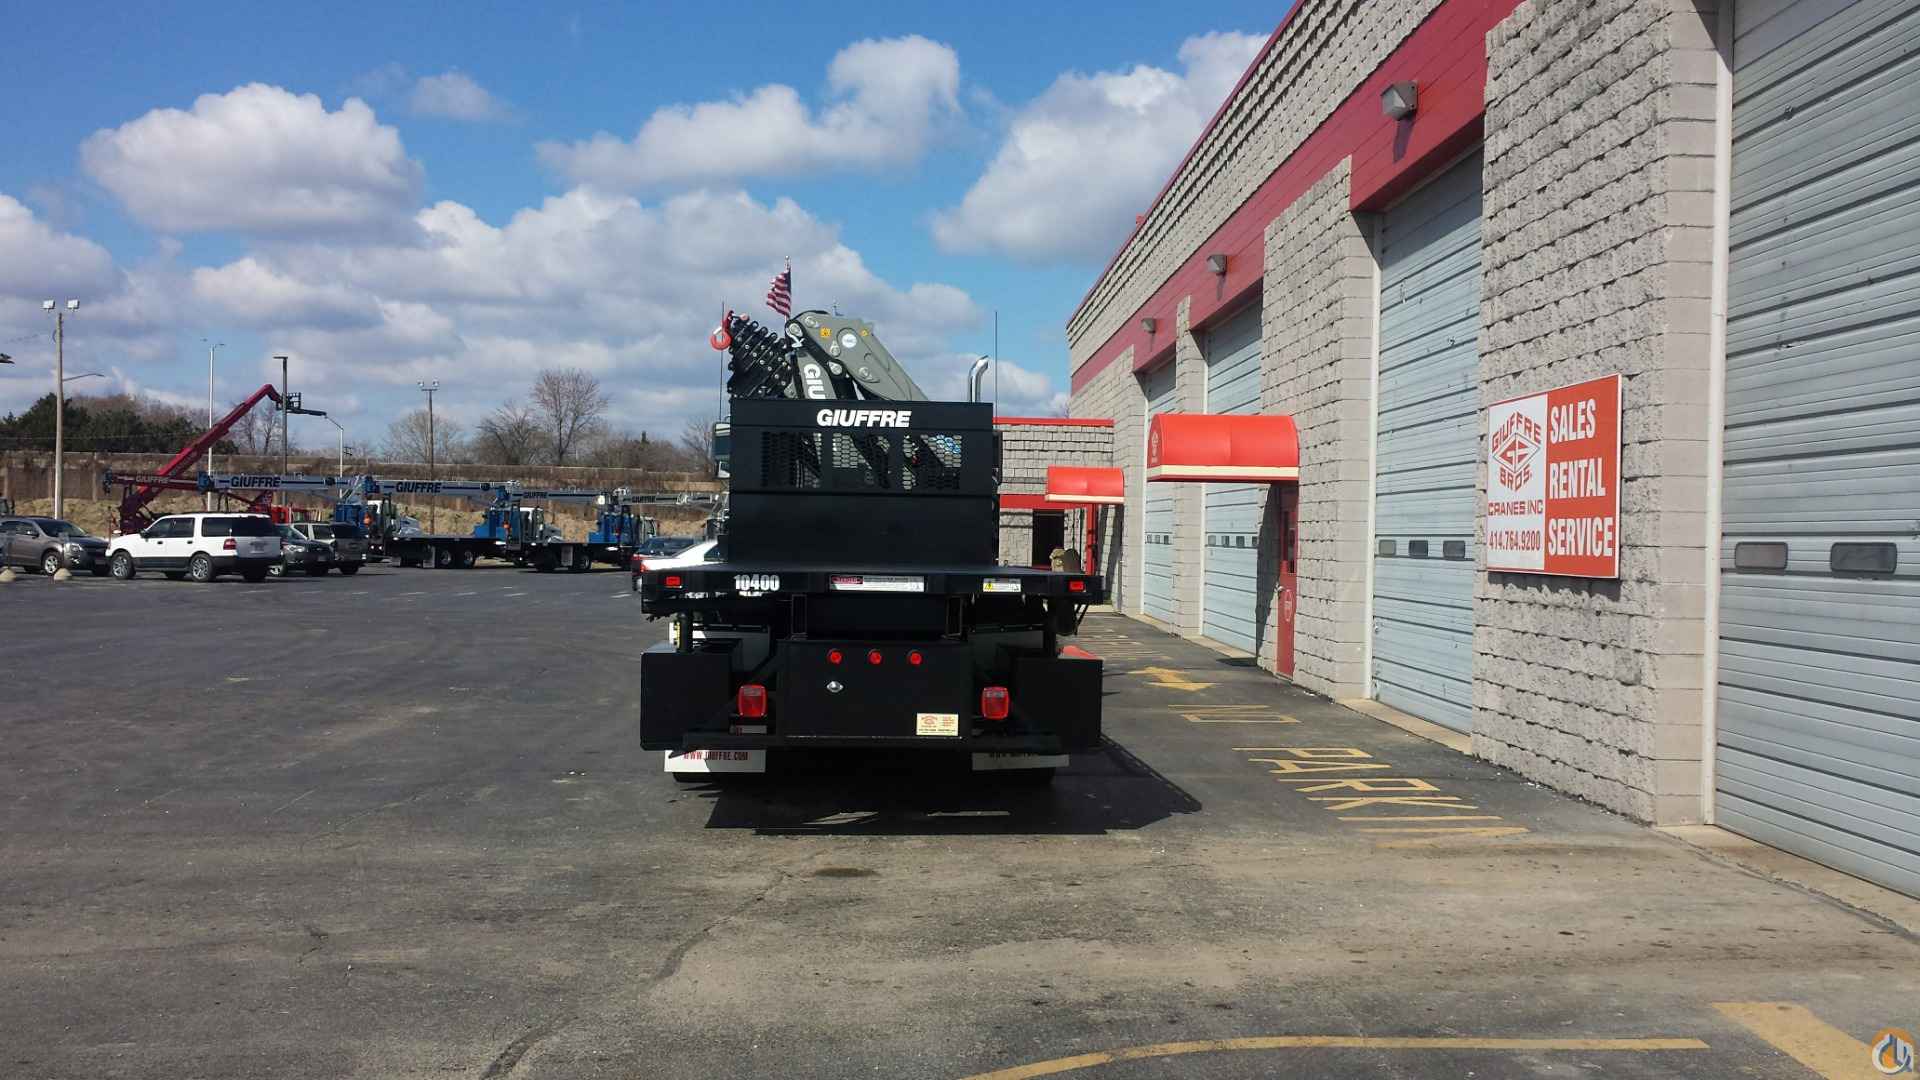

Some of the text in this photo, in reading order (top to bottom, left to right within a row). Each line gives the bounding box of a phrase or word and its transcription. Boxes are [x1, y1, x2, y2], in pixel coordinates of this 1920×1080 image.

[816, 408, 912, 428] GIUFFRE
[1550, 398, 1597, 445] SALES
[1492, 411, 1542, 454] GIUFFRE
[231, 476, 281, 488] GIUFFRE
[396, 481, 441, 493] GIUFFRE
[1549, 457, 1606, 499] RENTAL
[1488, 500, 1544, 516] CRANES INC
[1489, 530, 1541, 551] 414.764.9200
[1548, 516, 1614, 557] SERVICE
[734, 575, 780, 591] 10400
